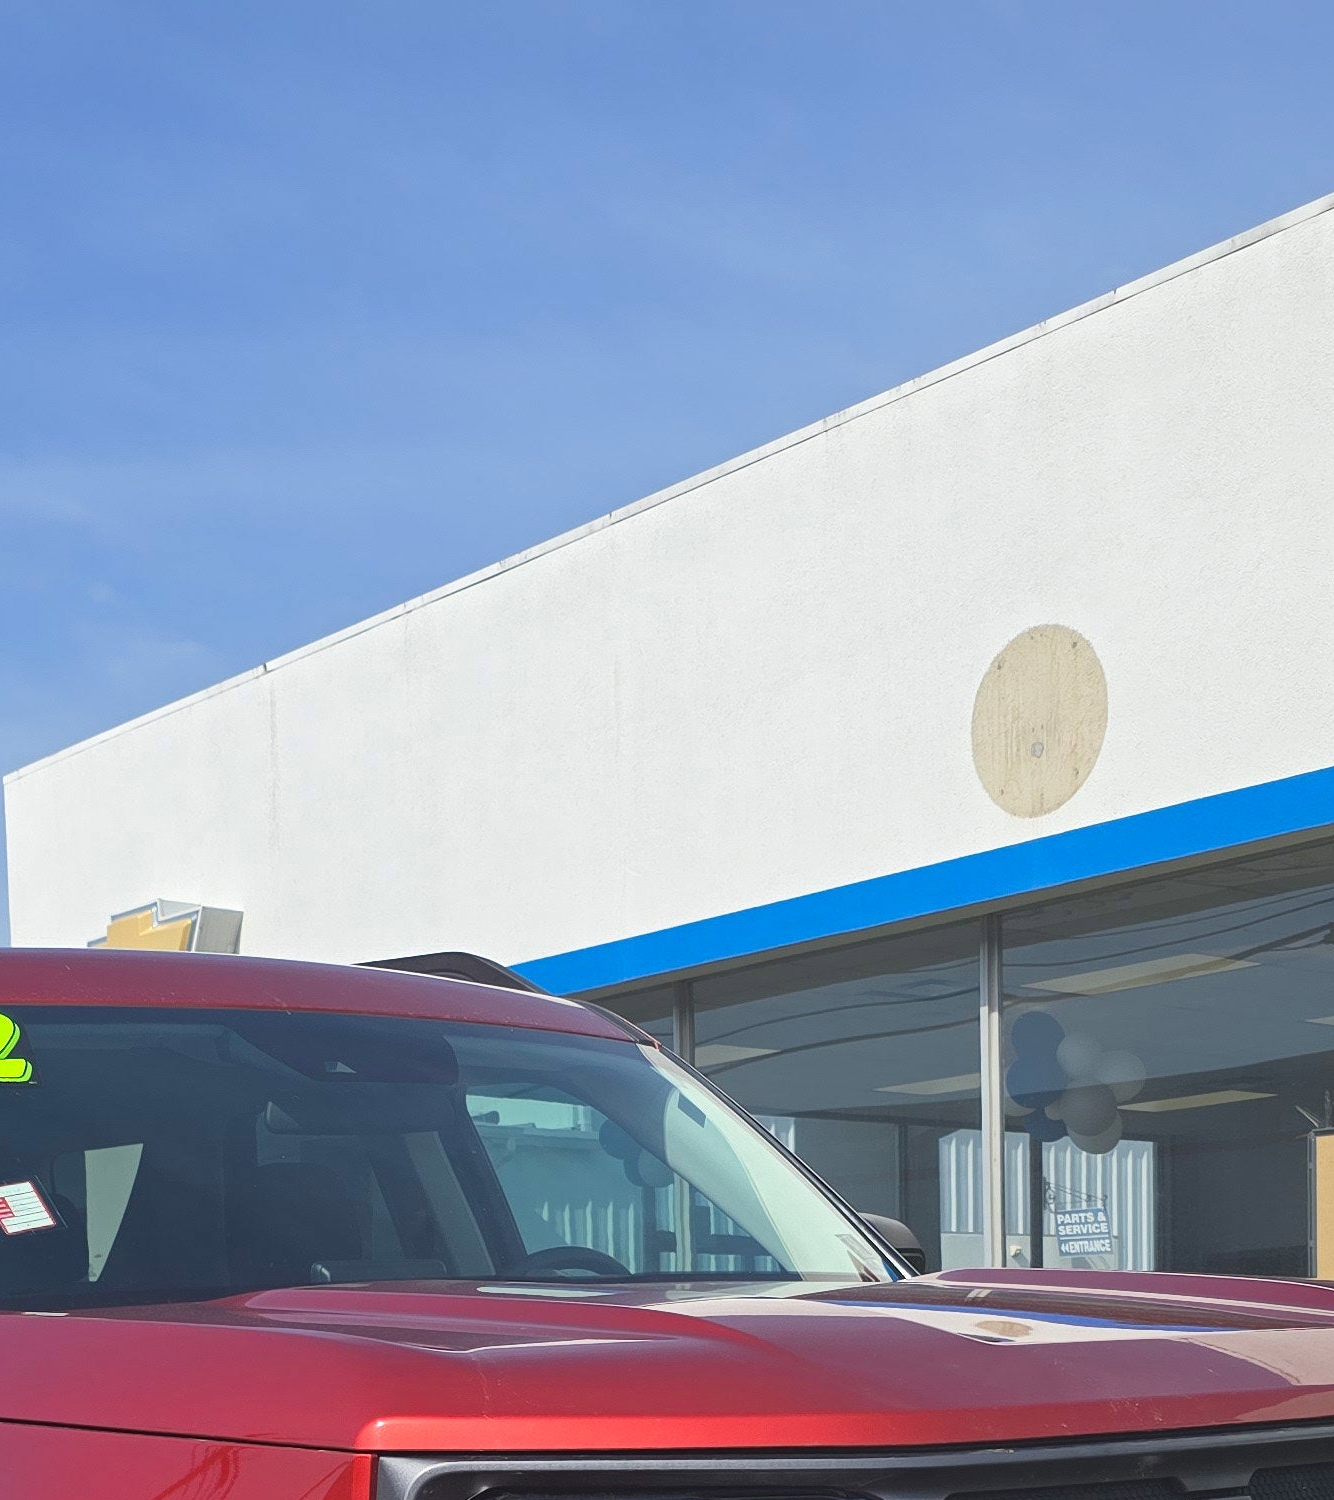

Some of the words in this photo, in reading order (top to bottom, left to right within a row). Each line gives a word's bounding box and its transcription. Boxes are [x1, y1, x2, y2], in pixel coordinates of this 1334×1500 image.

[1057, 1212, 1094, 1224] PARTS
[1097, 1212, 1106, 1222] &
[1058, 1222, 1109, 1235] SERVICE
[1069, 1239, 1111, 1253] ENTRANCE
